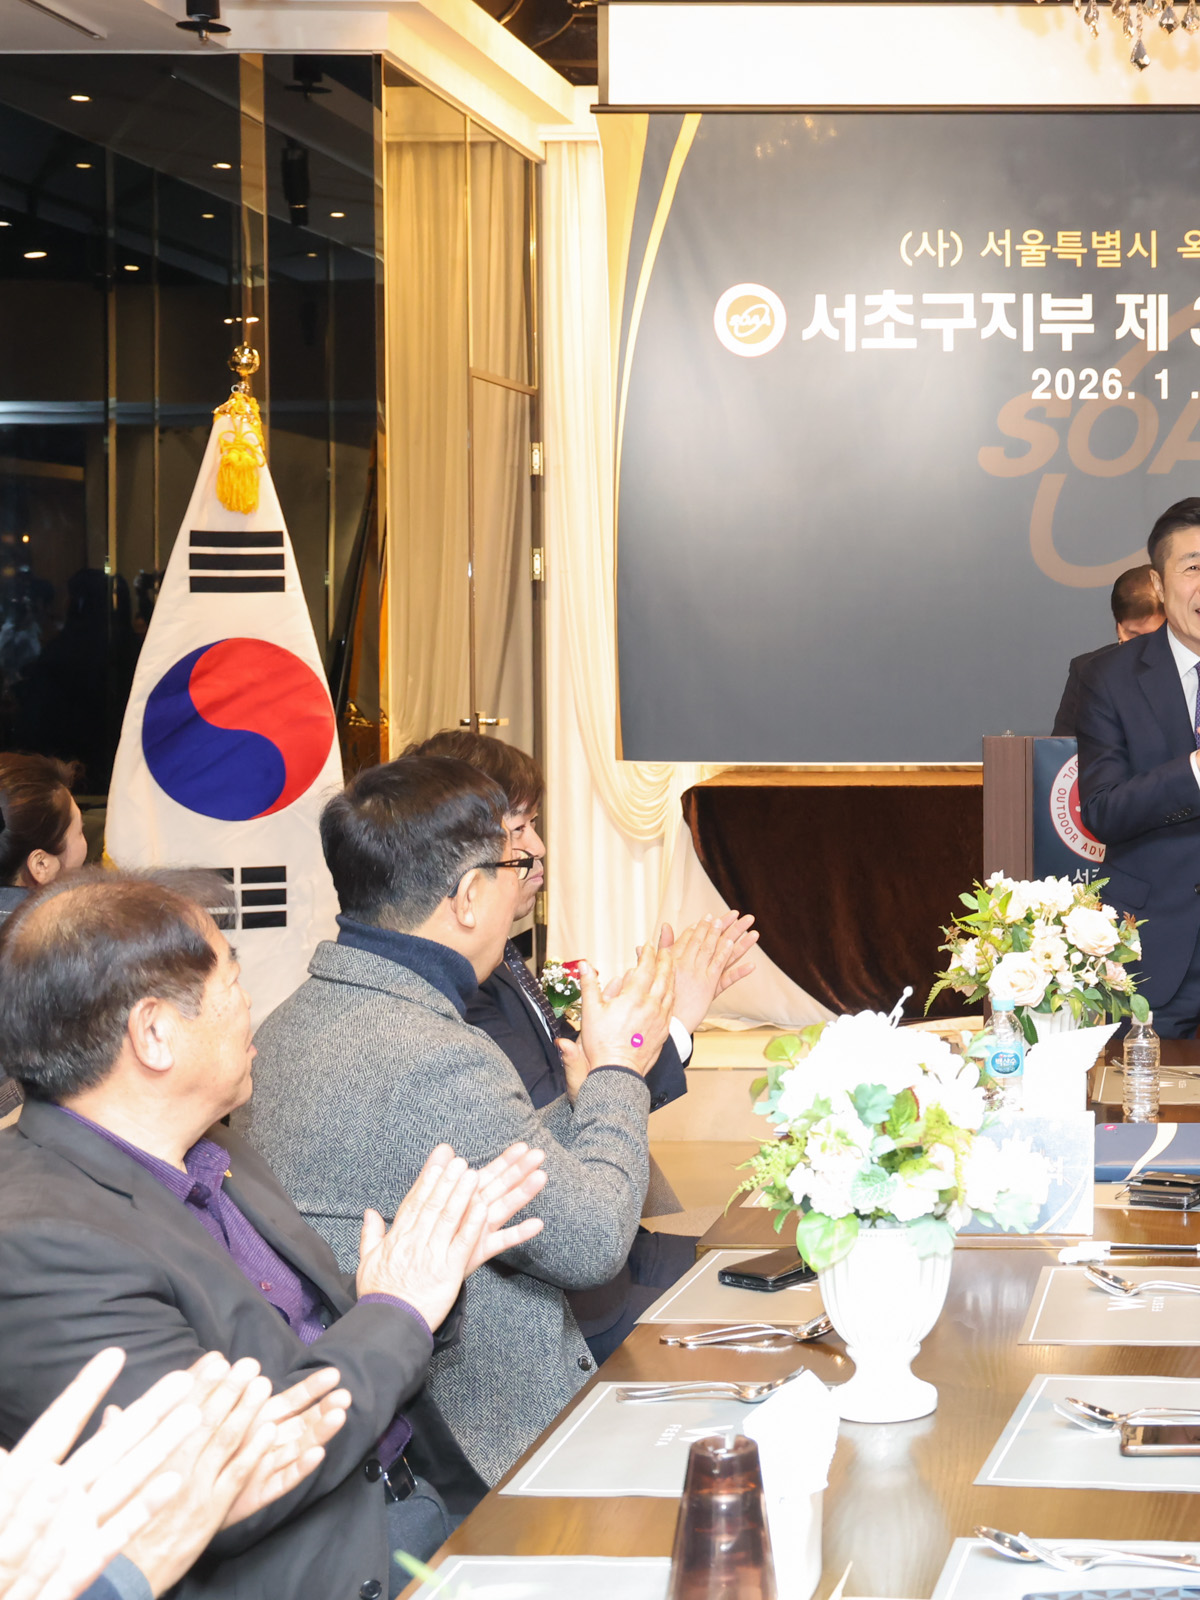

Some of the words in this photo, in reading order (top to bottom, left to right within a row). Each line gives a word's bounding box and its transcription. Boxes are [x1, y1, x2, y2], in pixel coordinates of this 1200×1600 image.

[899, 229, 964, 268] (사)
[980, 228, 1158, 268] 서울특별시
[801, 288, 1095, 353] 서초구지부
[1115, 292, 1169, 352] 제
[1056, 787, 1079, 844] OUTDOOR
